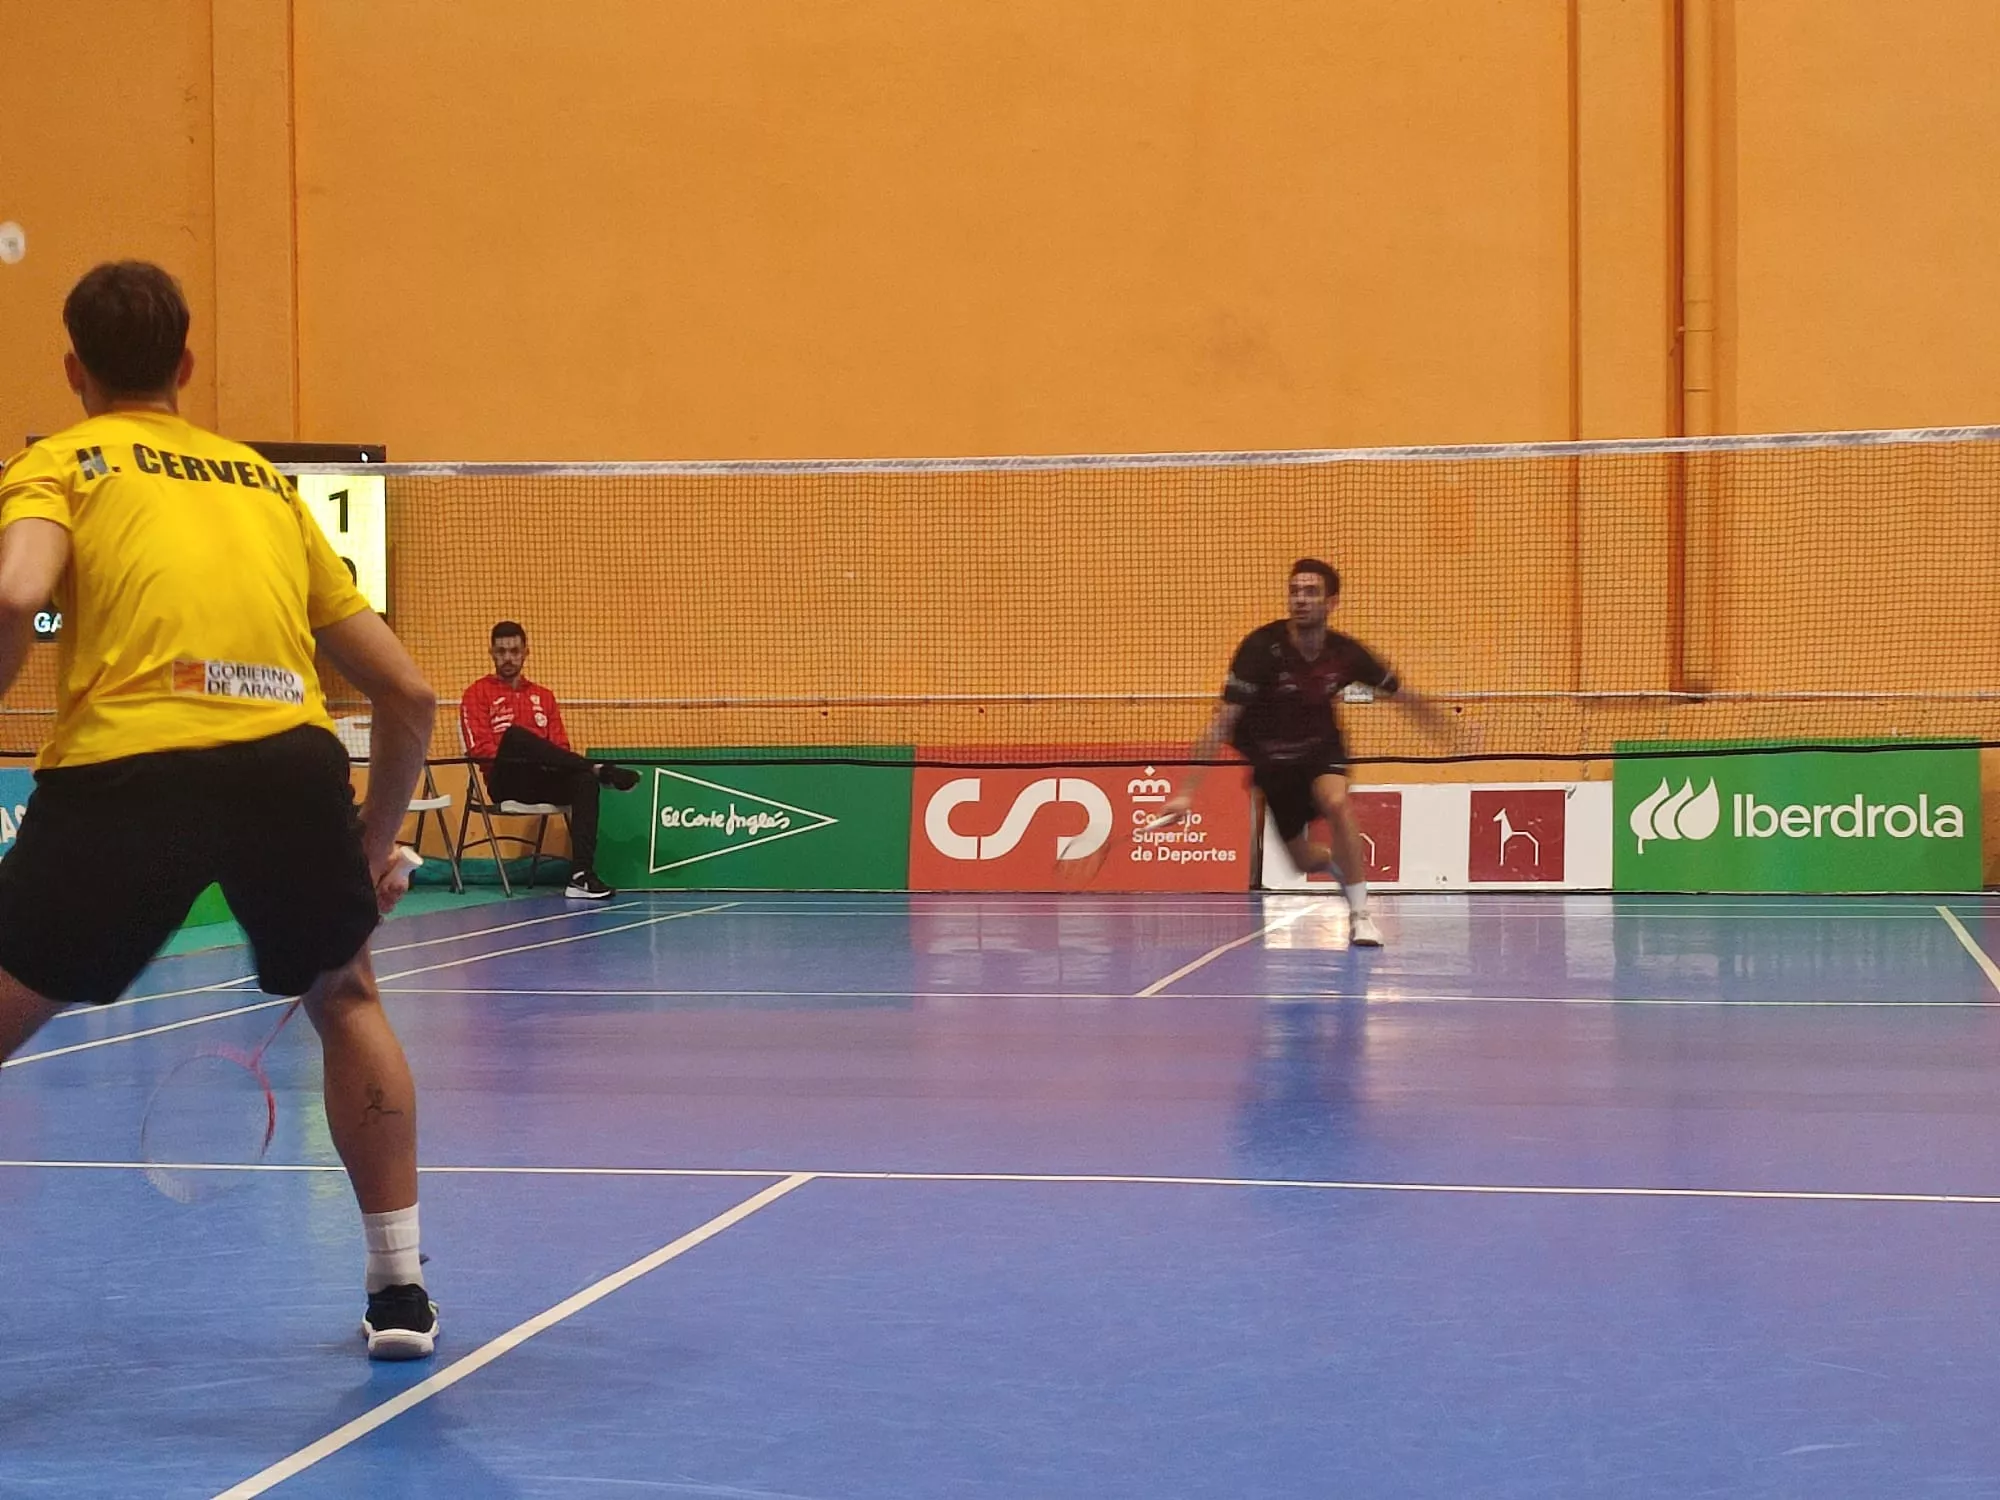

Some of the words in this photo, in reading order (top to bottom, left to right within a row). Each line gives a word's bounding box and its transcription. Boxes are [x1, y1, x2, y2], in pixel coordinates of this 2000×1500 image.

[76, 446, 121, 480] N.
[328, 489, 348, 533] 1
[208, 663, 295, 688] GOBIERNO
[207, 681, 232, 696] DE
[661, 806, 680, 828] El
[680, 807, 725, 828] Corte
[725, 803, 791, 836] Inglés
[1132, 809, 1202, 829] Cojo
[1733, 794, 1964, 838] Iberdrola
[1132, 828, 1208, 846] Superior
[1131, 846, 1153, 861] de
[1157, 846, 1237, 865] Deportes
